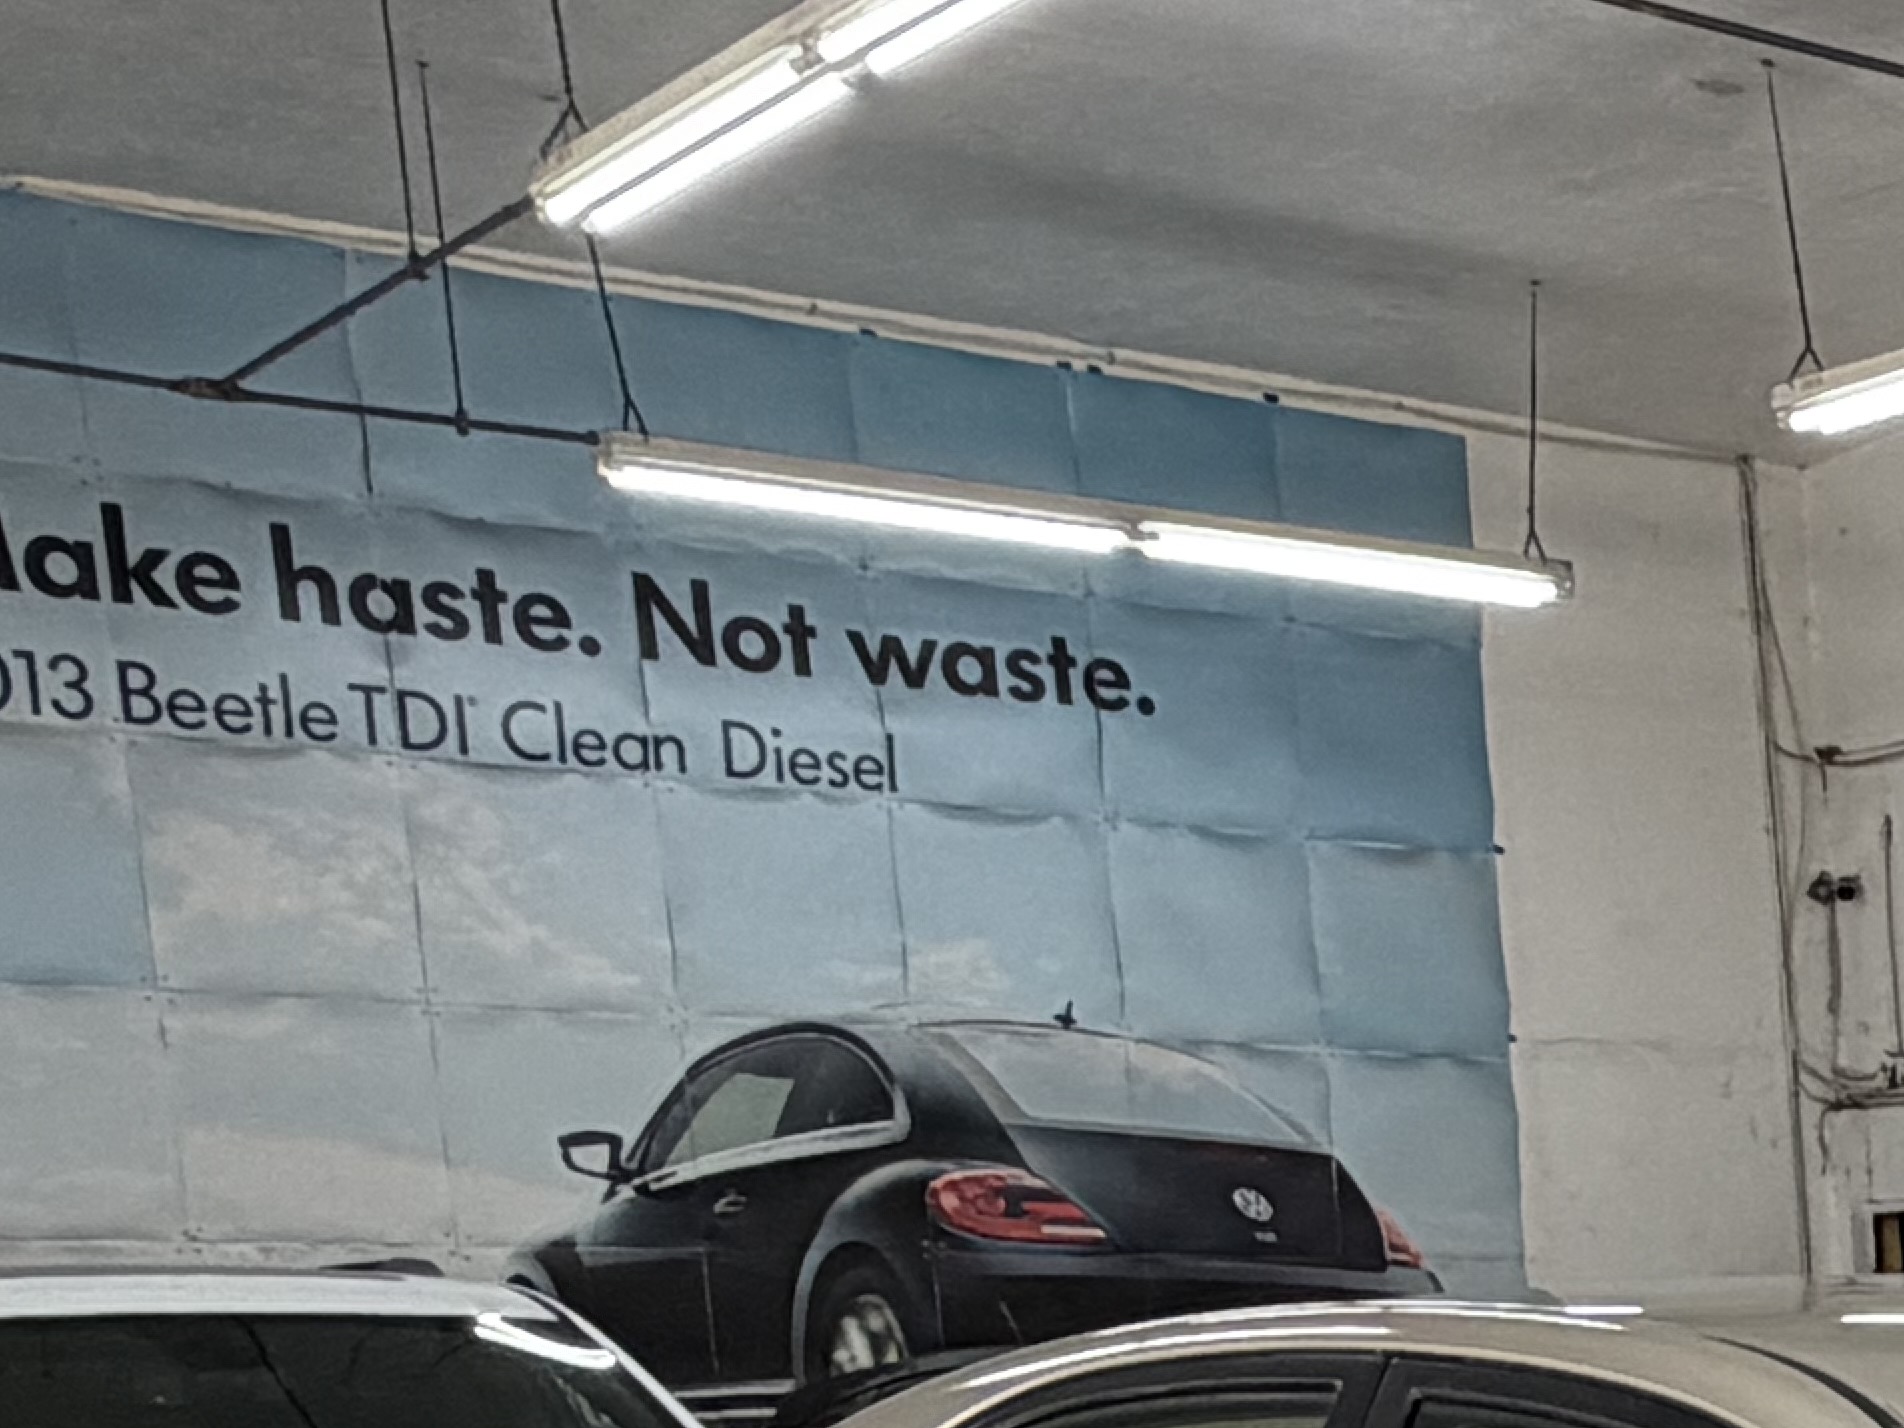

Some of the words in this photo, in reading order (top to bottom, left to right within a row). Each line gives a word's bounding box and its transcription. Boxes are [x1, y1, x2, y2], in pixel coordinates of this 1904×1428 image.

[269, 522, 602, 658] haste.
[631, 570, 817, 678] Not
[845, 627, 1158, 718] waste.
[115, 659, 338, 743] Beetle
[501, 699, 687, 775] Clean
[720, 718, 898, 794] Diesel
